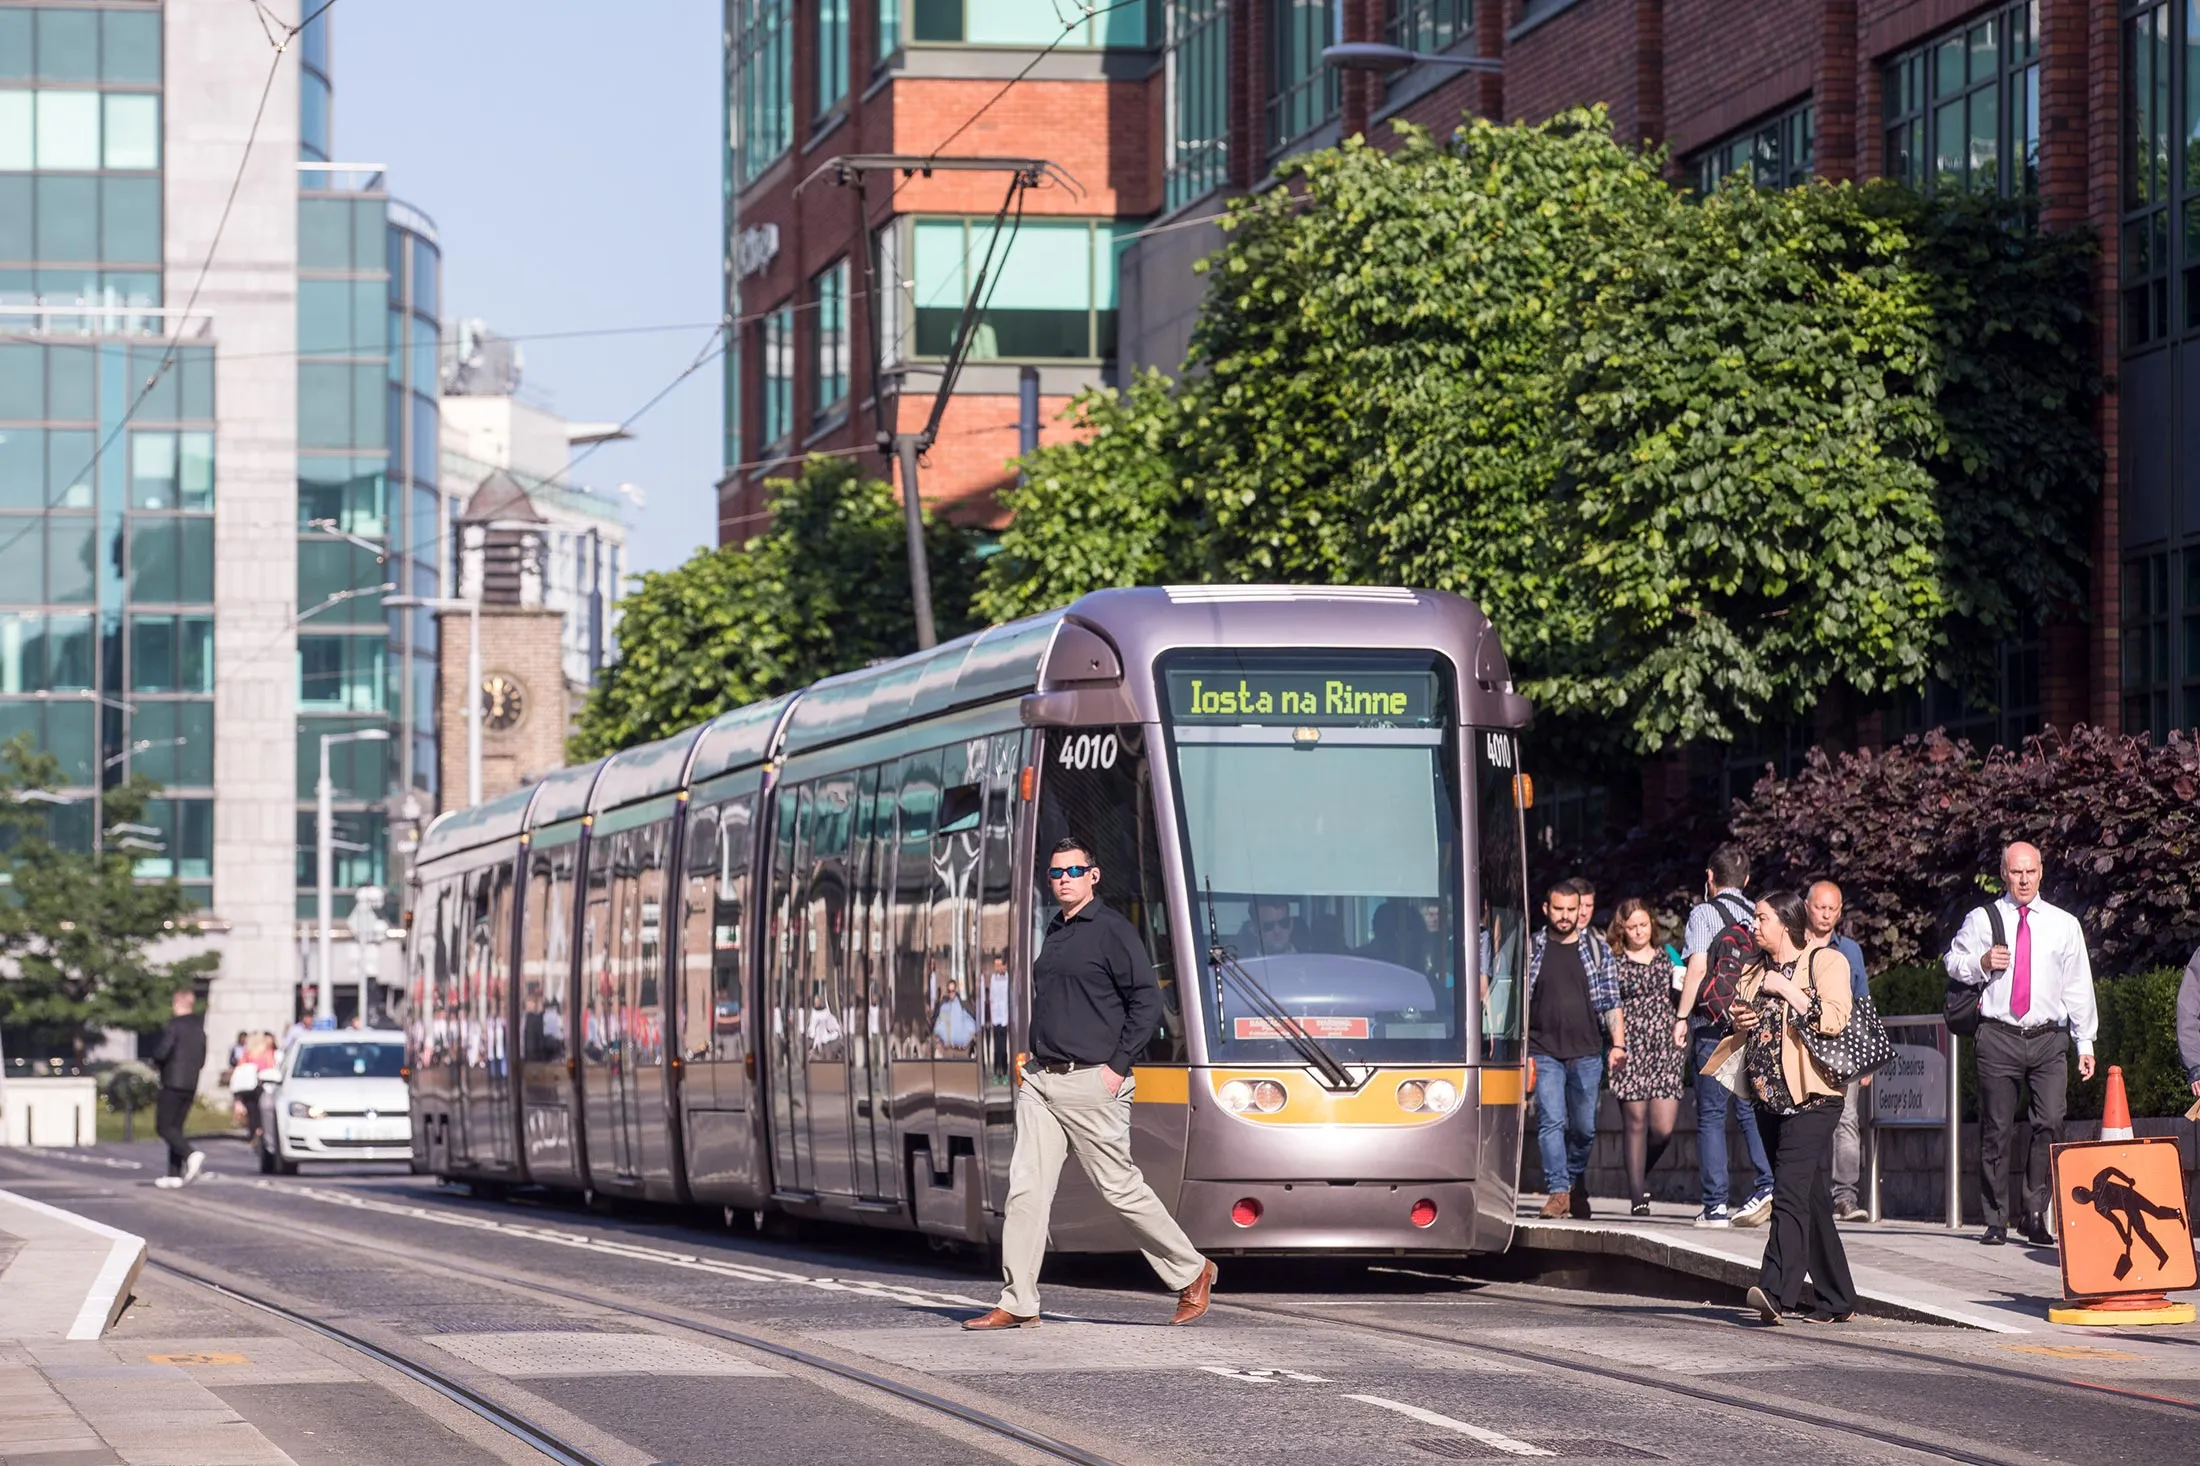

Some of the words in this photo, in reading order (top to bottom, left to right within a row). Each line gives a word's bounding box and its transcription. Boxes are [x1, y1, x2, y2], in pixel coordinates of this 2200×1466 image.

[1191, 680, 1273, 715] Iosta
[1282, 691, 1317, 715] na
[1325, 680, 1408, 715] Rinne
[1059, 733, 1118, 770] 4010
[1486, 732, 1512, 769] 4010
[1879, 1088, 1907, 1114] George's
[1908, 1087, 1924, 1109] Dock
